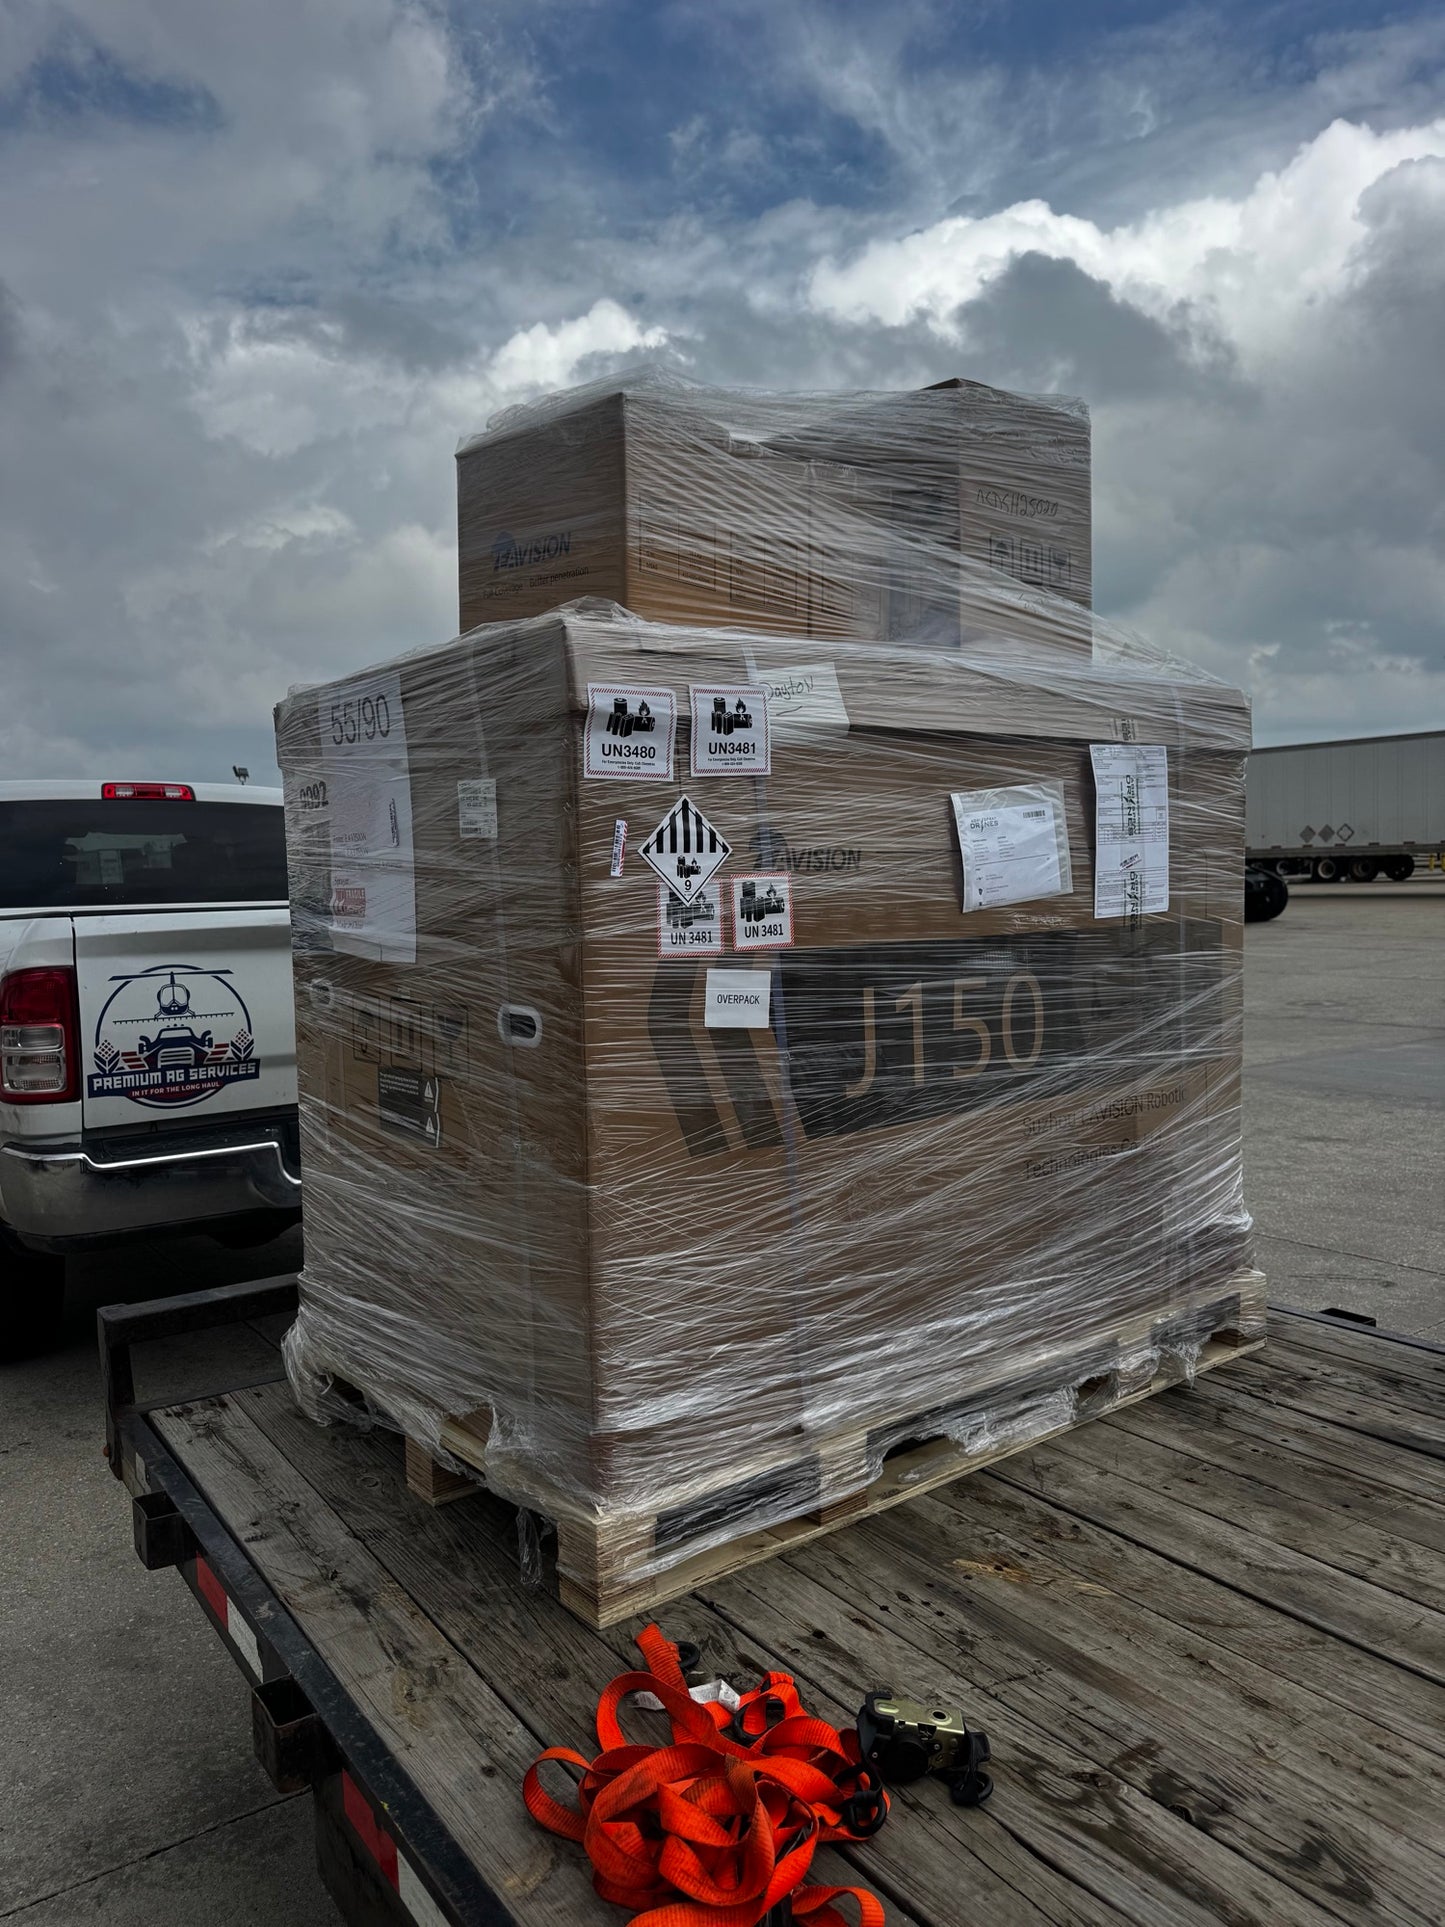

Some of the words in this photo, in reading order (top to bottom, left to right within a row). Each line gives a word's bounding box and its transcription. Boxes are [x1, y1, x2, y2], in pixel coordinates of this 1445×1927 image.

[550, 566, 589, 585] penetration
[601, 743, 656, 759] UN3480
[708, 742, 756, 755] UN3481
[684, 880, 692, 891] 9
[670, 932, 686, 945] UN
[688, 931, 713, 943] 3481
[744, 926, 759, 938] UN
[761, 924, 784, 937] 3481
[717, 994, 760, 1005] OVERPACK
[844, 970, 1044, 1099] J150
[92, 1072, 162, 1091] PREMIUM
[166, 1069, 185, 1083] AG
[189, 1062, 257, 1080] SERVICES
[150, 1087, 165, 1095] FOR
[201, 1081, 220, 1089] HAUL
[1147, 1084, 1185, 1110] Robotic
